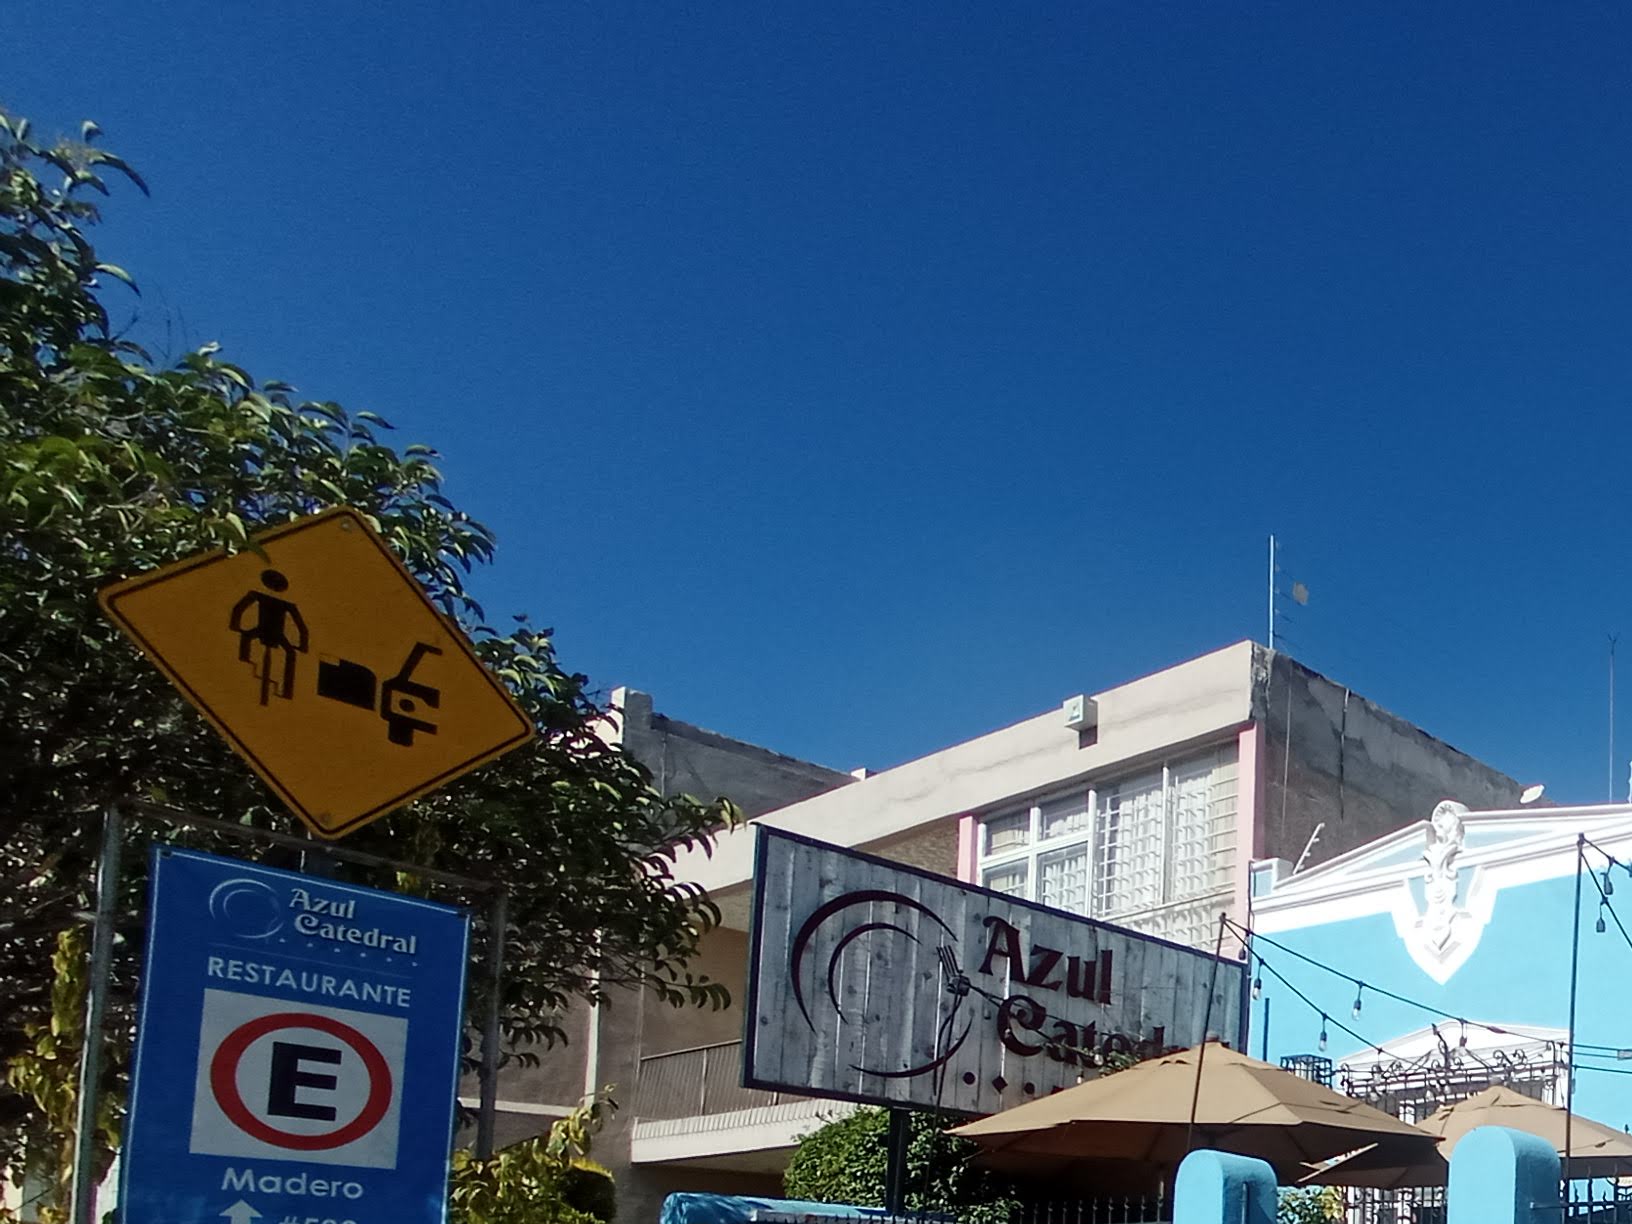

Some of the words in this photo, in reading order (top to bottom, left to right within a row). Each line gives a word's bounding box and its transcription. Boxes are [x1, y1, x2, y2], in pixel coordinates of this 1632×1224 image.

[288, 887, 356, 920] Azul
[294, 913, 417, 954] Catedral
[207, 956, 411, 1008] RESTAURANTE
[978, 916, 1113, 1005] Azul
[267, 1041, 342, 1121] E
[220, 1166, 364, 1200] Madero
